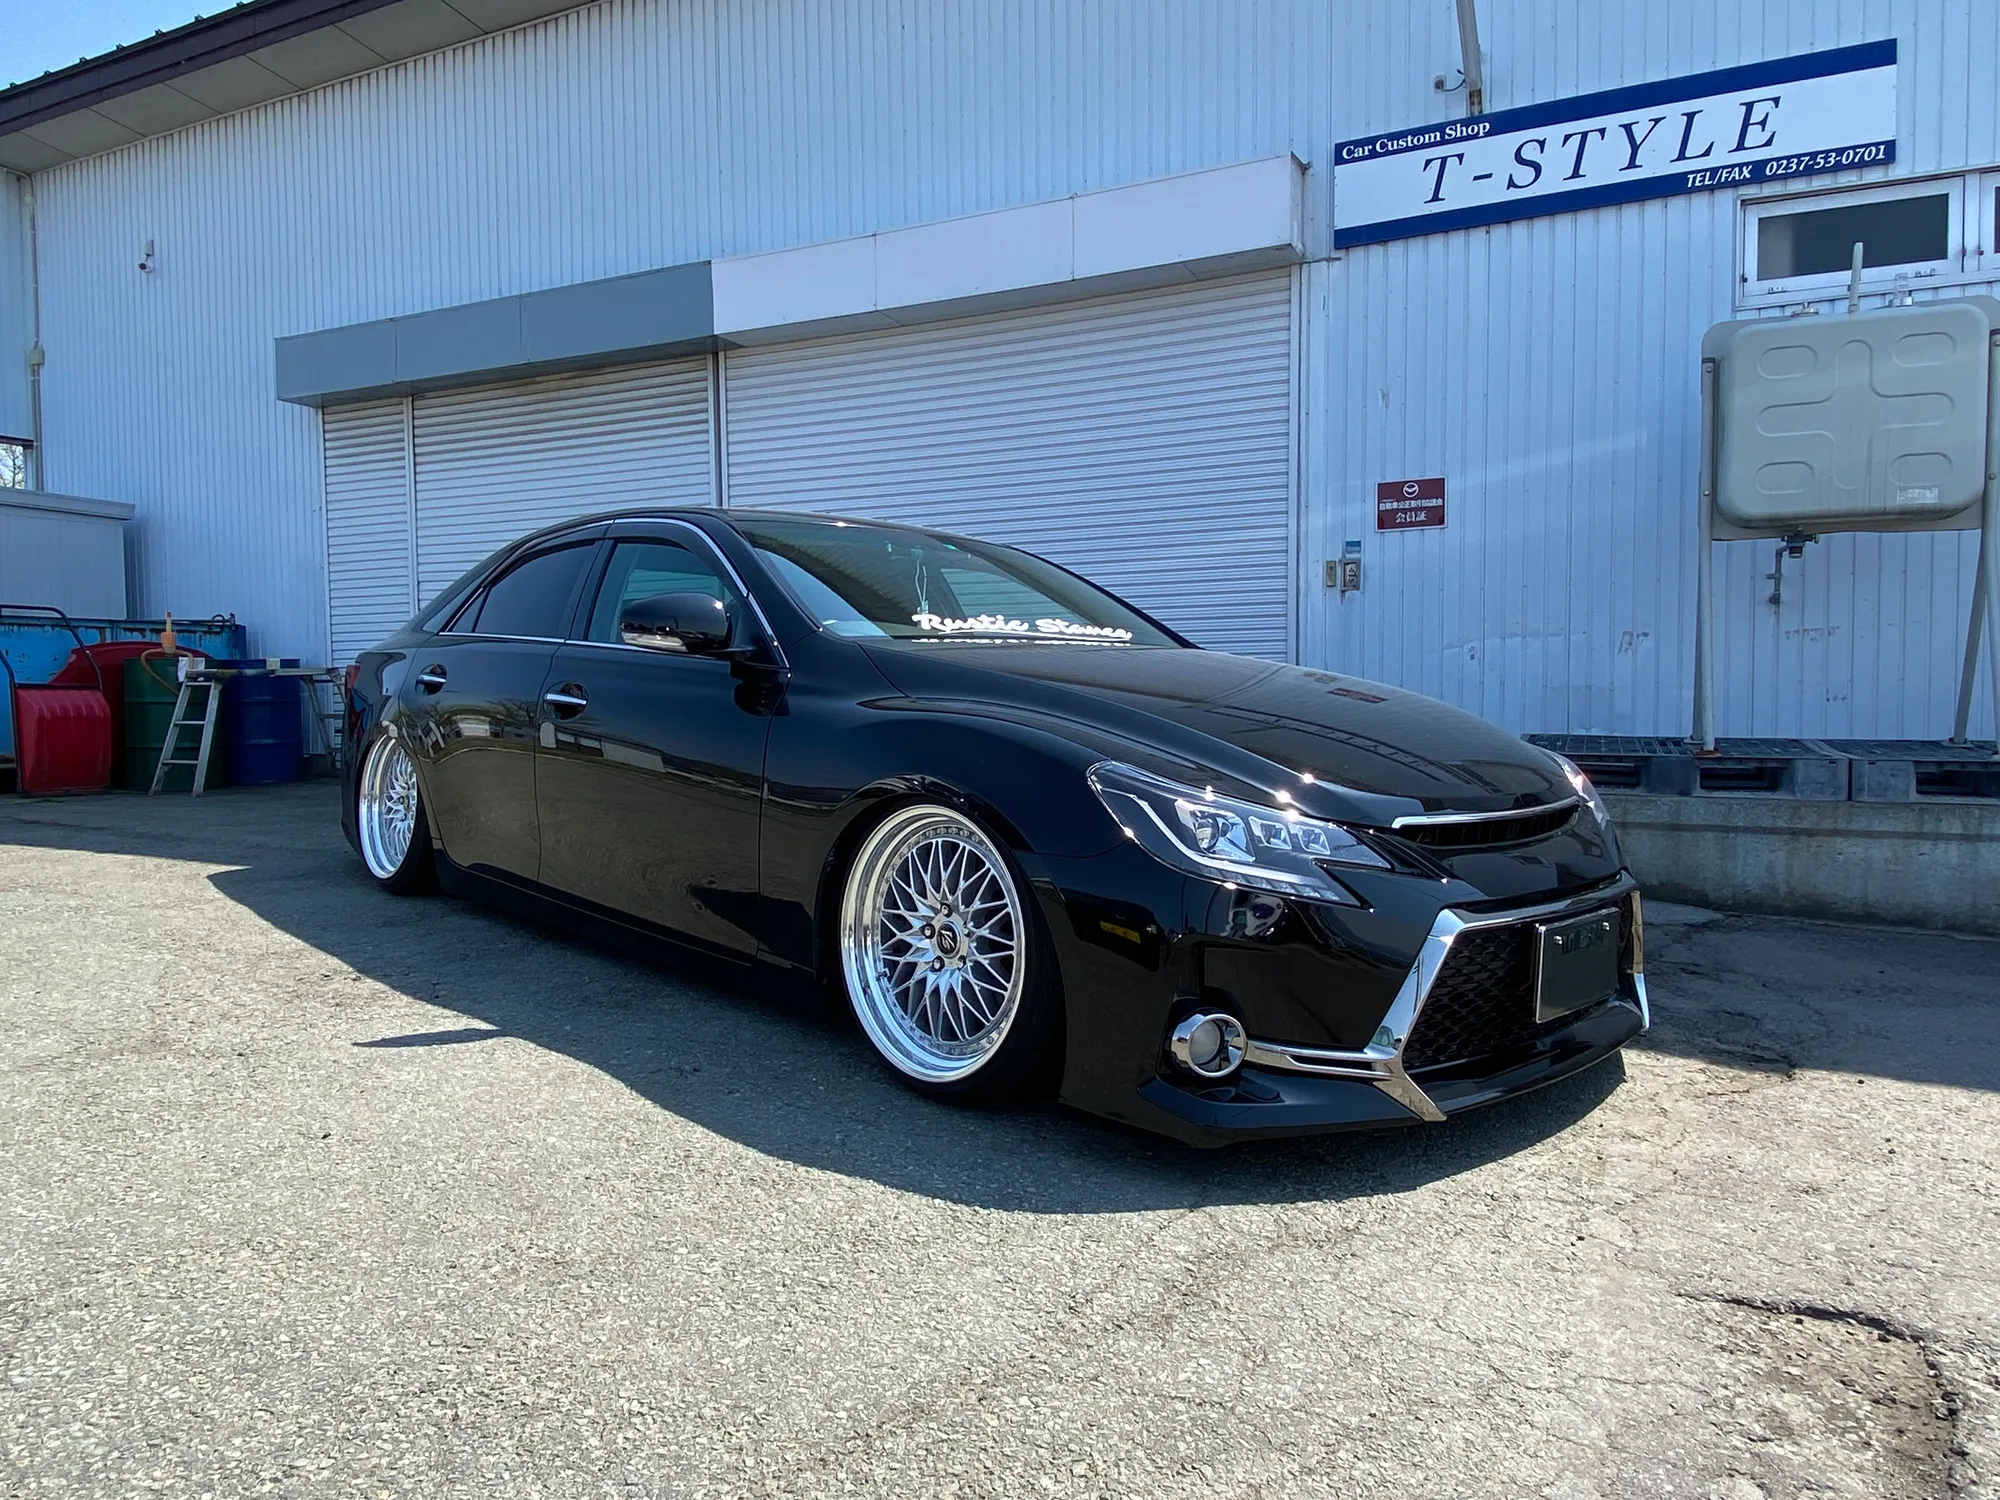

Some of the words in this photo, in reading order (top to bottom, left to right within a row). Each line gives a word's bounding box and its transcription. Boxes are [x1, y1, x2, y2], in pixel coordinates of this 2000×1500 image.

[1342, 145, 1373, 160] Car
[1375, 131, 1441, 153] Custom
[1444, 122, 1491, 140] Shop
[1422, 95, 1782, 204] T-STYLE
[1686, 164, 1753, 188] TEL/FAX
[1765, 144, 1886, 176] 0237-53-0701
[911, 614, 1029, 633] Rustic
